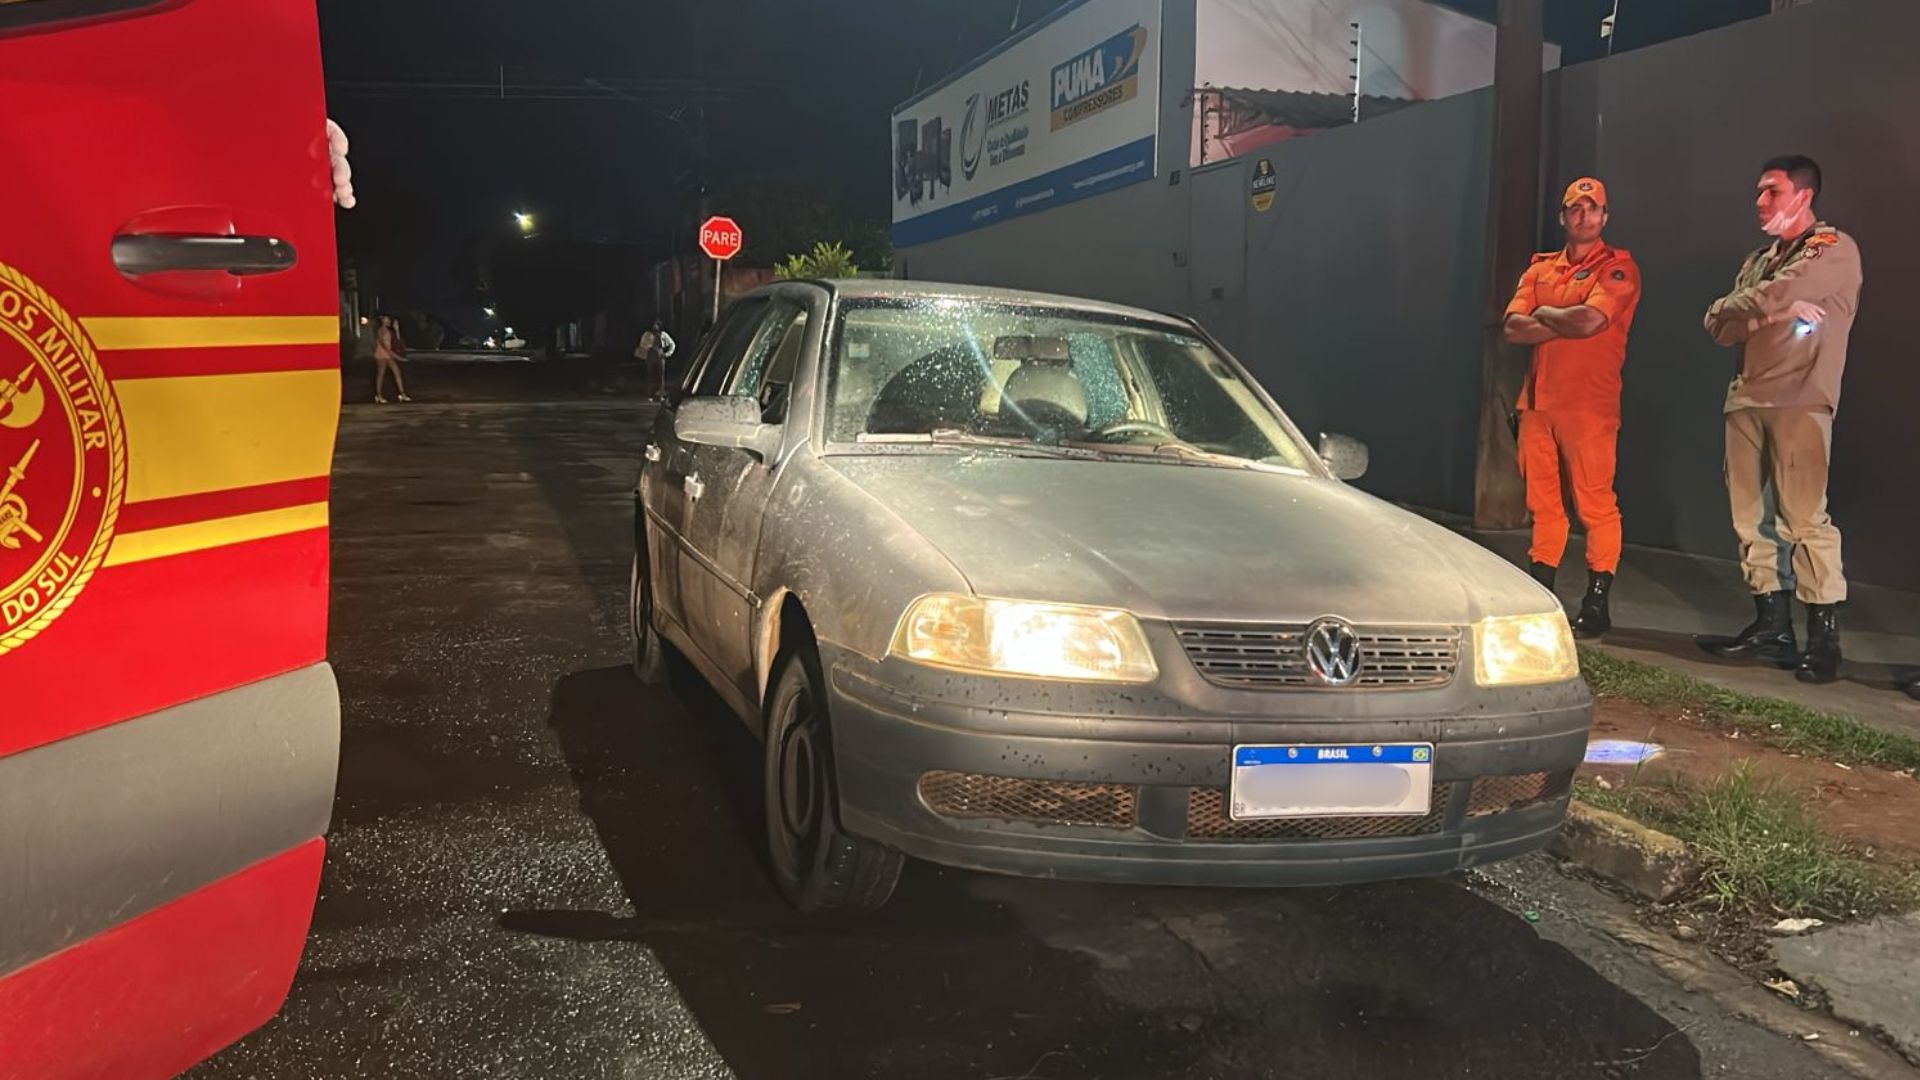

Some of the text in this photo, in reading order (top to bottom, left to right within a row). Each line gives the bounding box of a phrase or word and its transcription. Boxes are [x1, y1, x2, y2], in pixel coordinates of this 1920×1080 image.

[1054, 48, 1105, 107] PUMA
[987, 80, 1029, 123] METAS
[1063, 84, 1123, 122] COMPRESSORES
[704, 230, 738, 247] PARE
[36, 326, 106, 451] MILITAR
[1, 551, 79, 626] DO SUL
[1317, 748, 1349, 760] BRASIL
